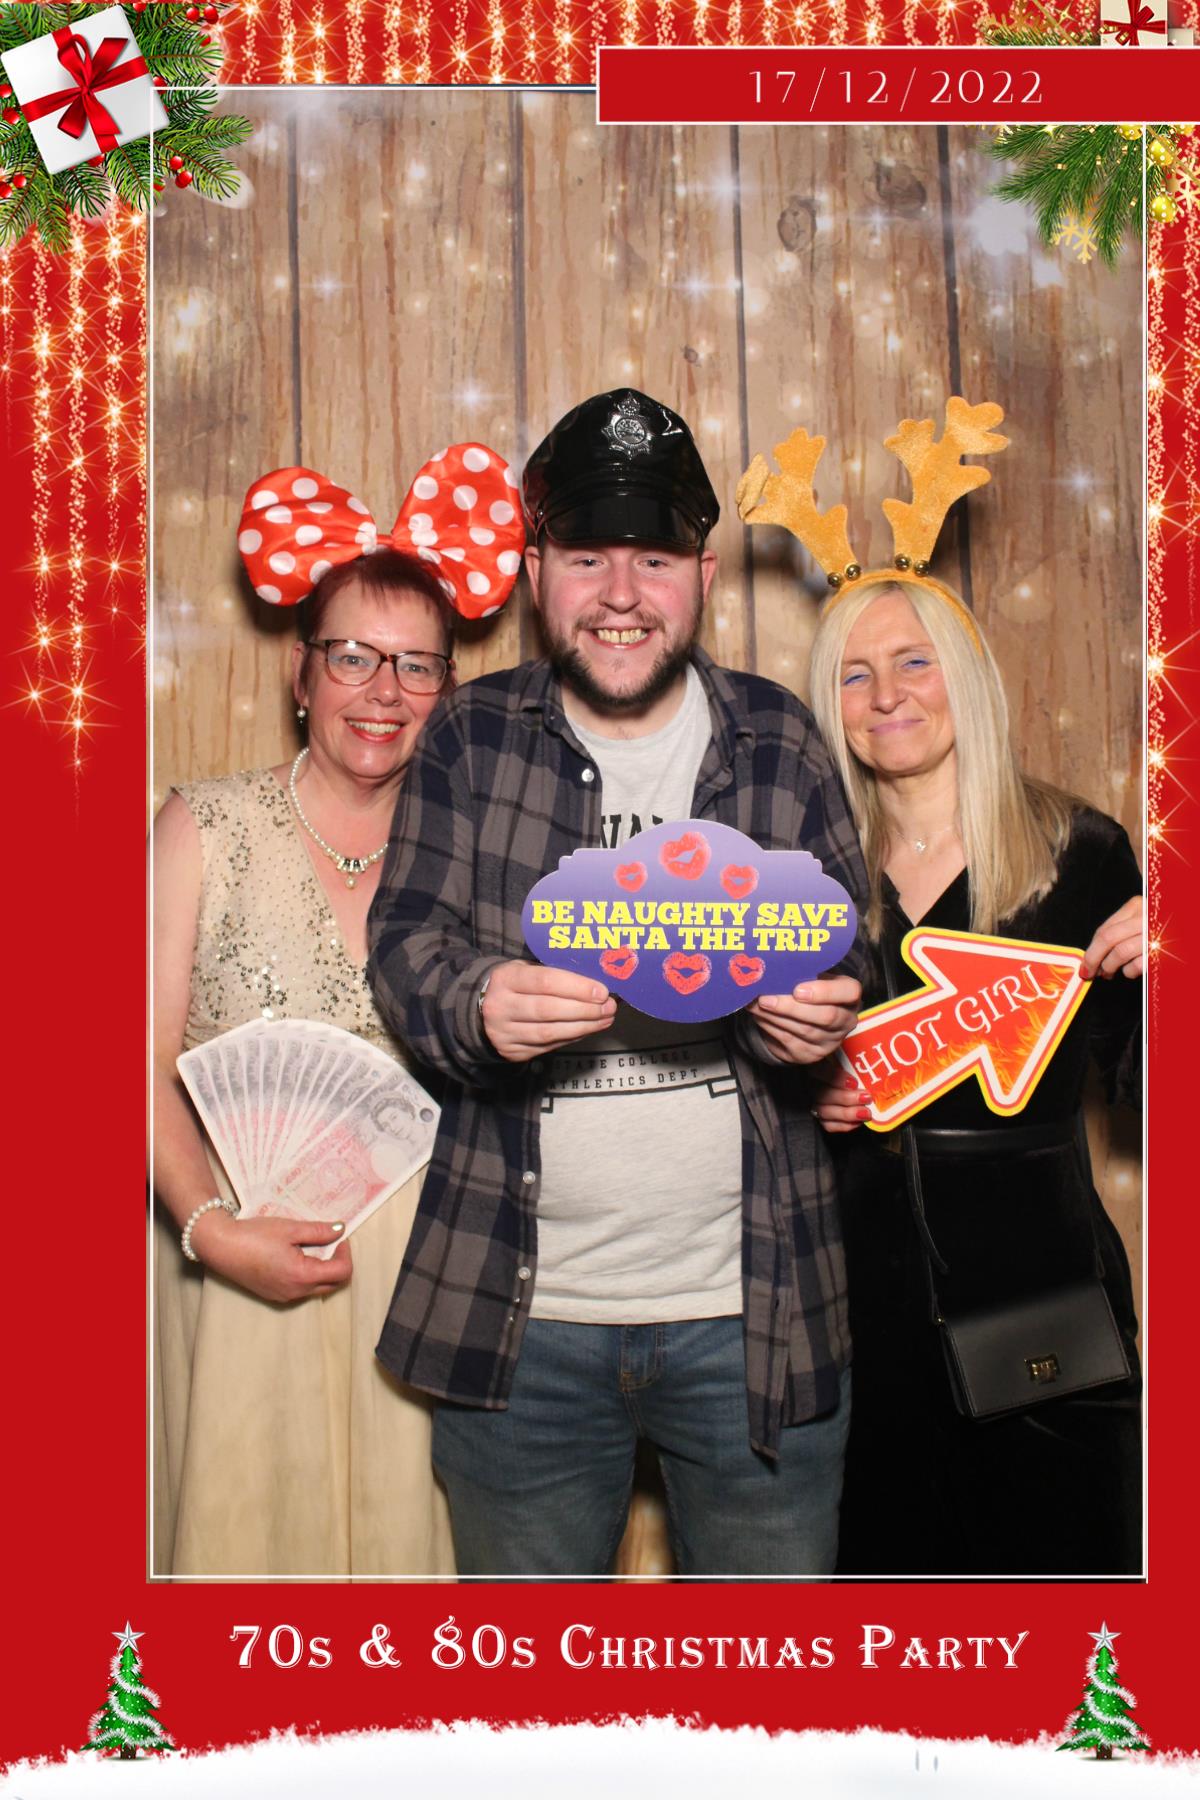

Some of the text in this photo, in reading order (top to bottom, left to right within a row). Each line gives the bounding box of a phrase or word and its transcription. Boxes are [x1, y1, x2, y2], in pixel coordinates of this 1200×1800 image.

[531, 900, 848, 927] BE NAUGHTY SAVE
[548, 925, 831, 952] SANTA THE TRIP
[855, 963, 1061, 1085] HOT GIRL
[549, 1076, 646, 1090] ATHLETICS
